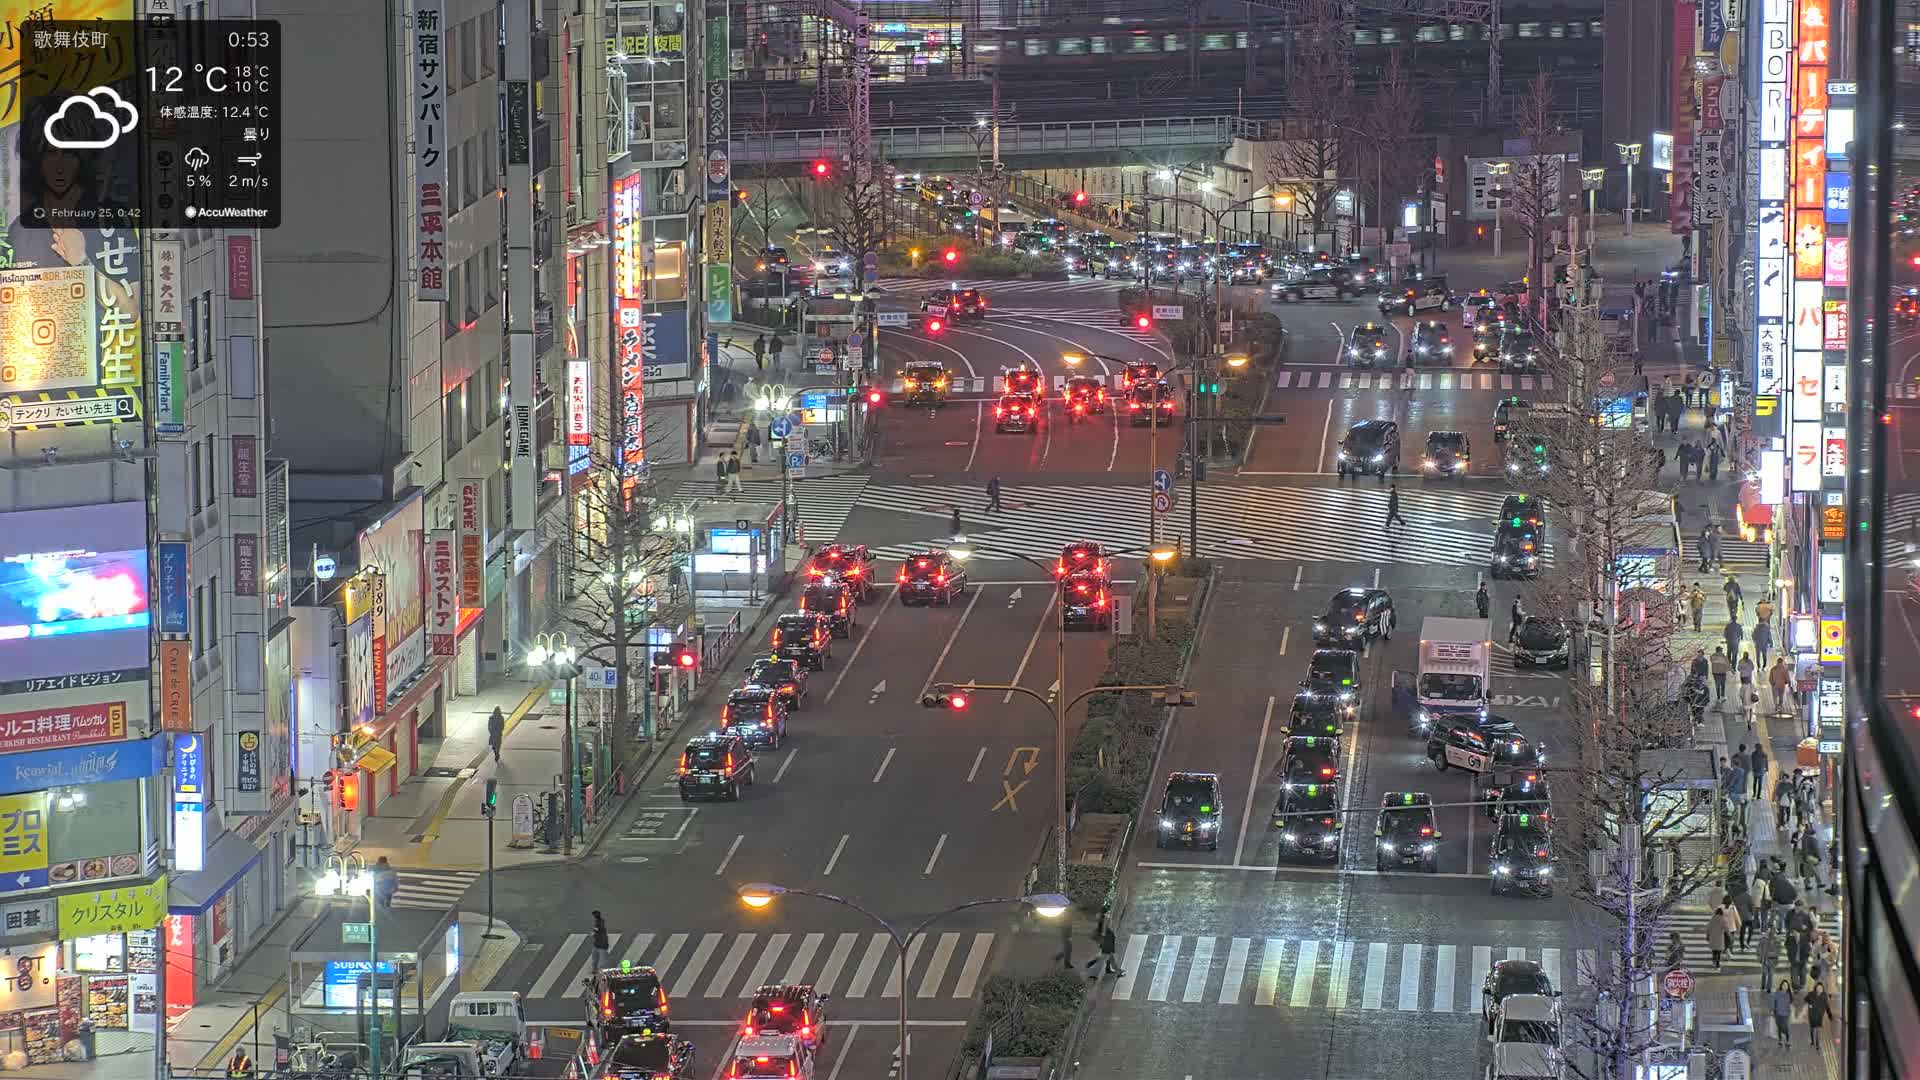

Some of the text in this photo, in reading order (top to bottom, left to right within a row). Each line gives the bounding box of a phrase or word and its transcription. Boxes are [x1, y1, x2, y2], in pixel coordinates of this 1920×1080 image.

[418, 10, 440, 167] 新宿サンパーク
[420, 182, 443, 289] 三平本館
[712, 206, 725, 261] 肉汁水餃子
[711, 273, 726, 311] レイク
[622, 328, 640, 386] ラーメン
[1761, 329, 1774, 380] 大衆酒場
[159, 351, 170, 413] FamilyMart
[1796, 306, 1820, 465] パセラ
[16, 401, 114, 419] テンクリ たいせい先生
[516, 405, 529, 458] HOMEGAME
[463, 485, 474, 529] GAME
[435, 541, 451, 627] 三平ストア
[111, 709, 121, 735] 5F
[6, 909, 41, 930] 囲碁
[72, 901, 143, 925] クリスタル
